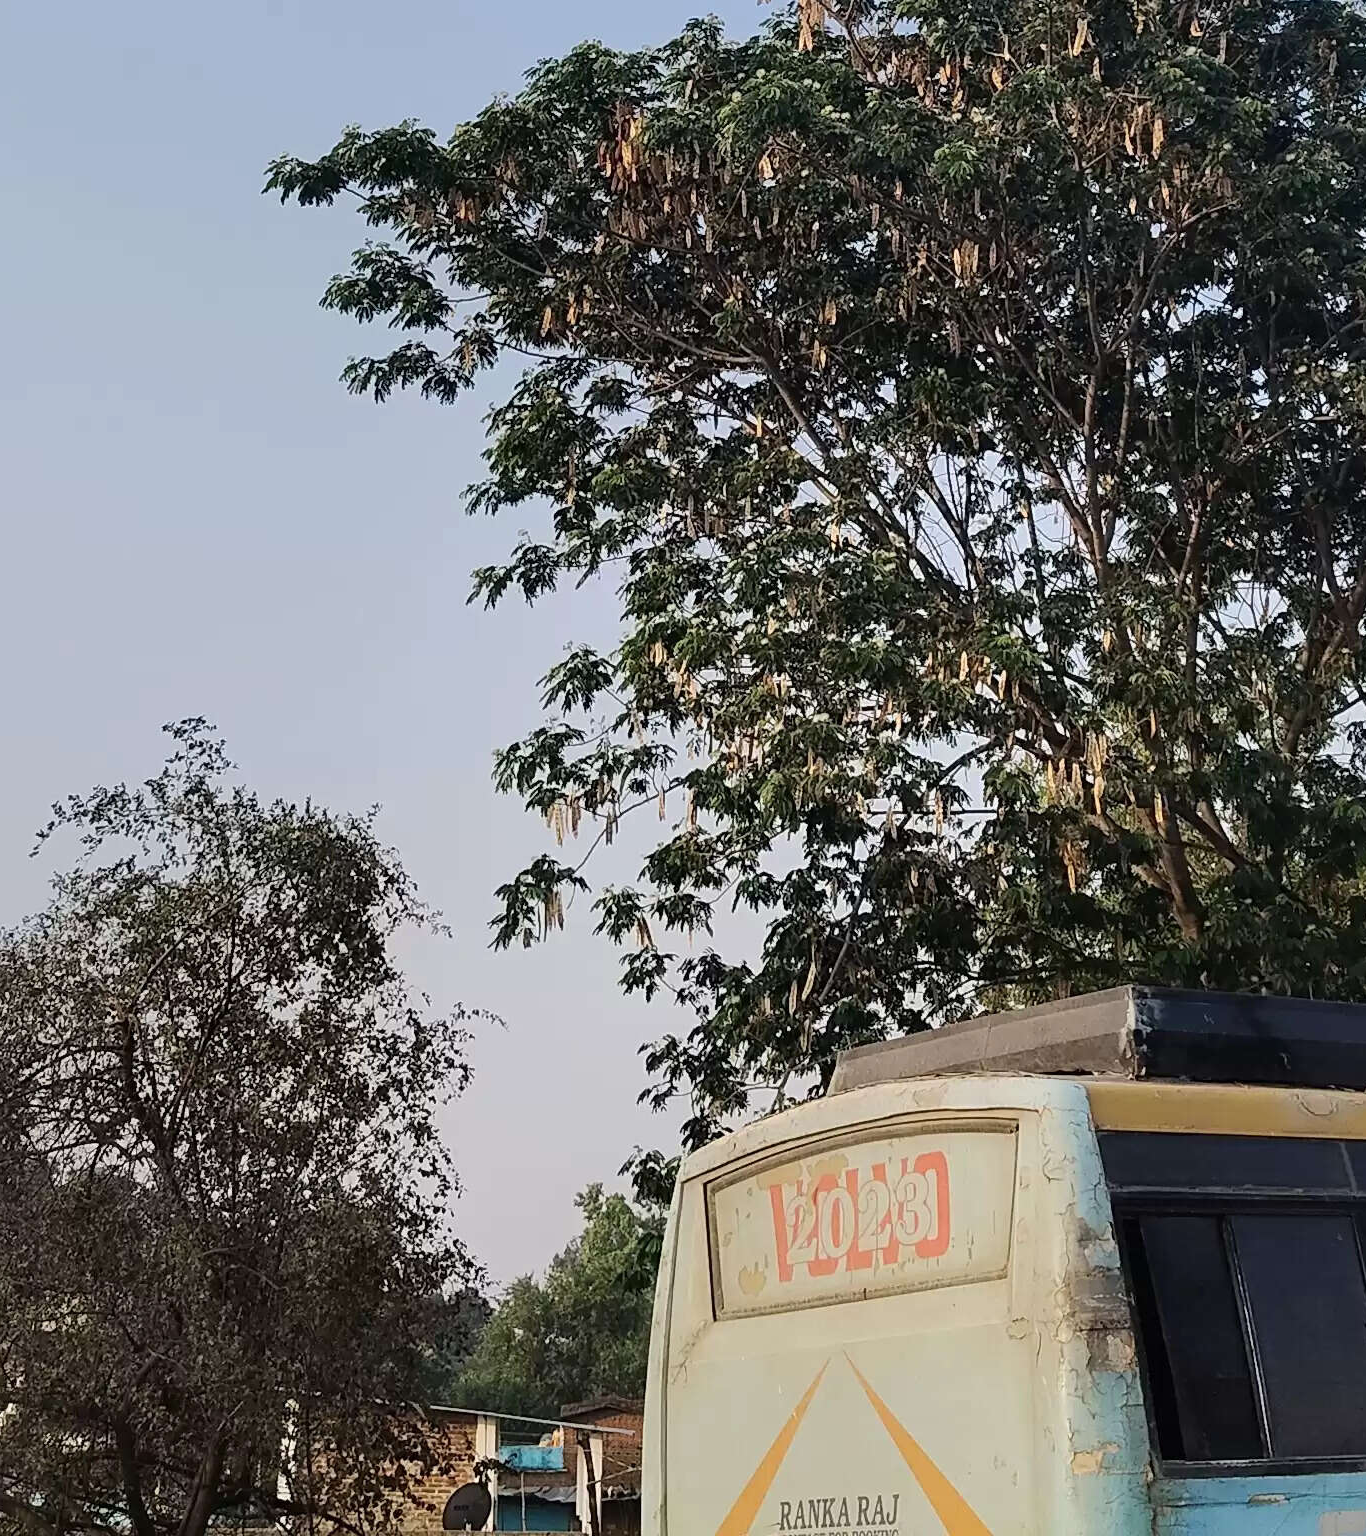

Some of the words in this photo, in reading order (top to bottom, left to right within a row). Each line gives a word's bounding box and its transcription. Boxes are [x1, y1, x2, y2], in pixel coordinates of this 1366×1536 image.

[787, 1173, 932, 1265] 2023
[779, 1497, 851, 1531] RANKA
[856, 1494, 899, 1526] RAJ
